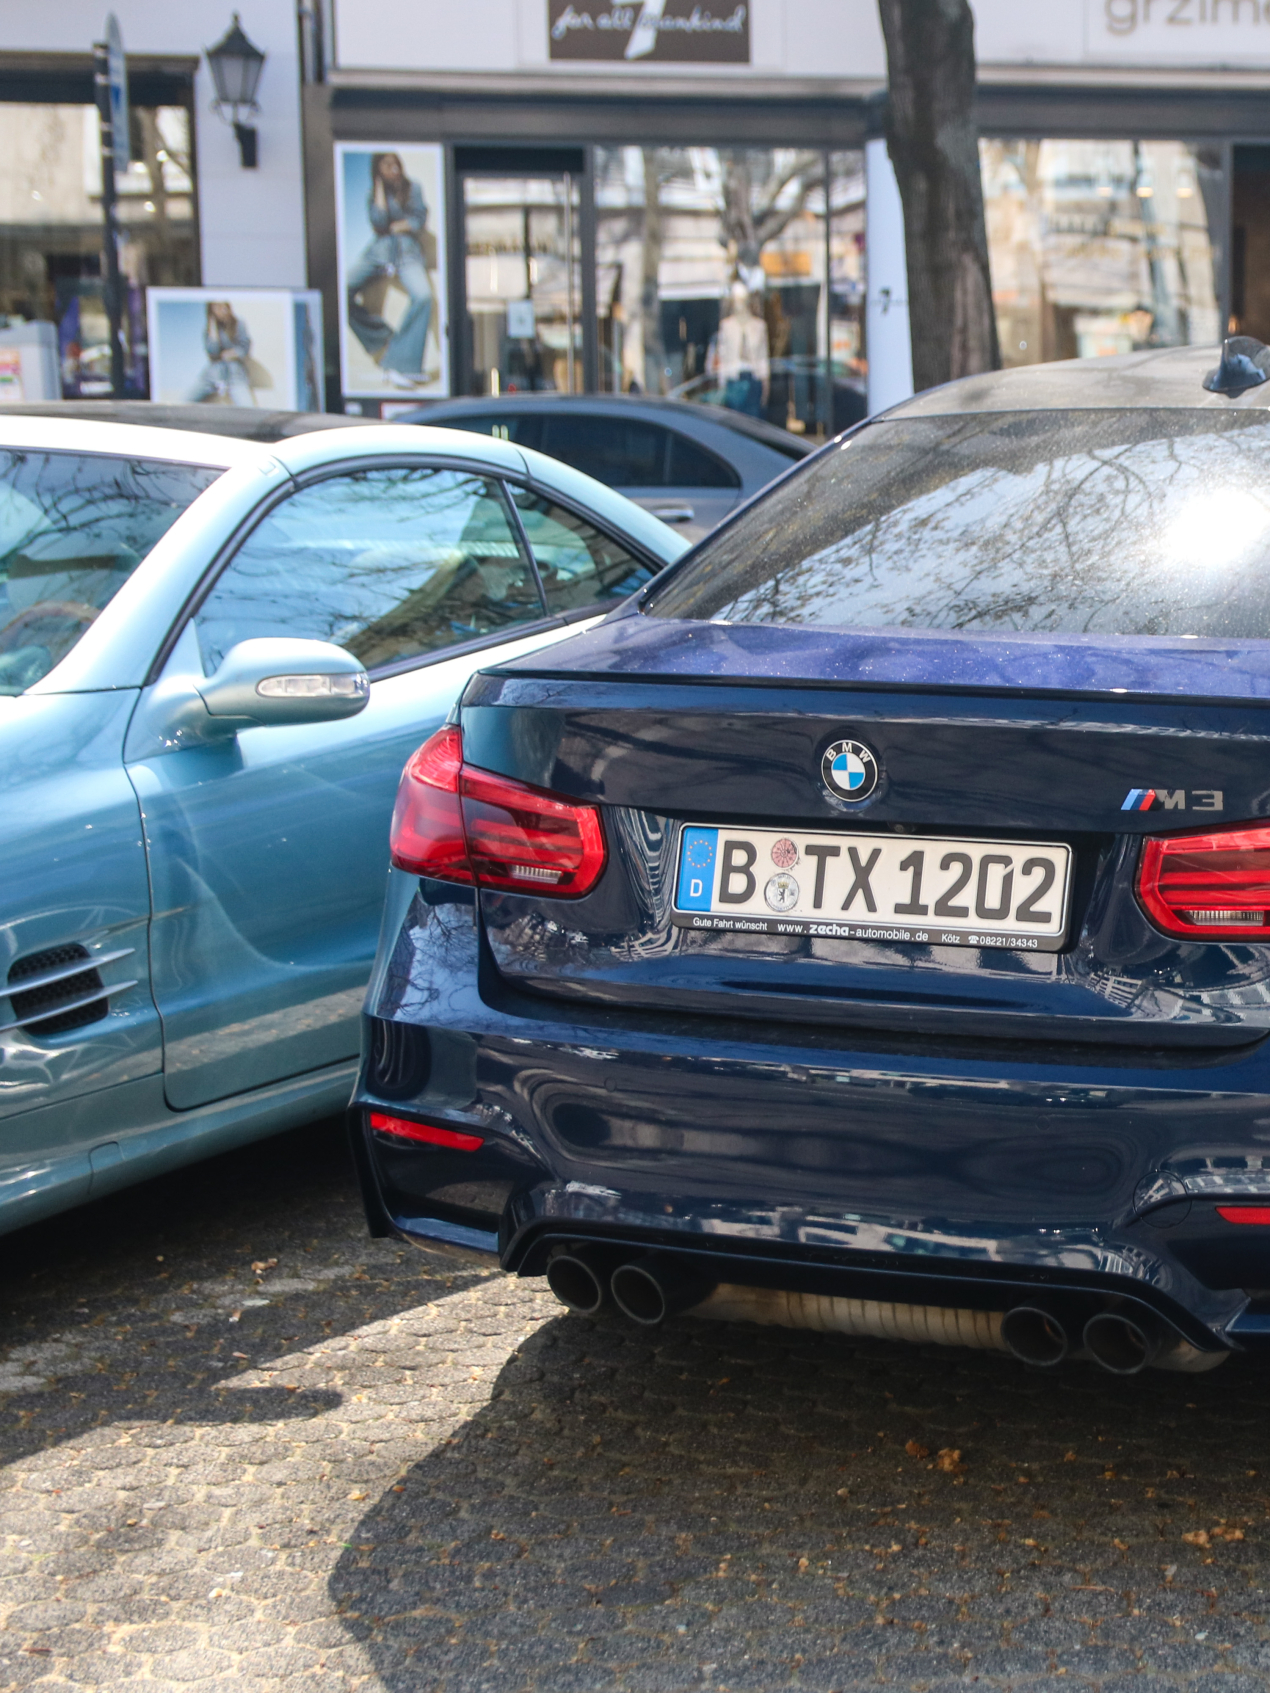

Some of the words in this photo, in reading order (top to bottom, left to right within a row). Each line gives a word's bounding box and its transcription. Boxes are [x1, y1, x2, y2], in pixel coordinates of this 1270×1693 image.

[551, 5, 594, 40] for
[597, 7, 634, 30] all
[638, 5, 746, 33] mankind
[826, 742, 872, 763] BMW
[1148, 789, 1224, 811] M3
[690, 879, 703, 897] D
[719, 840, 758, 904] B
[805, 845, 883, 913] TX
[894, 850, 1056, 923] 1202
[693, 917, 712, 927] Gute
[713, 918, 734, 929] Fahrt
[735, 919, 768, 931] wünscht
[941, 933, 961, 944] Kötz
[979, 935, 1038, 948] 08221/34343
